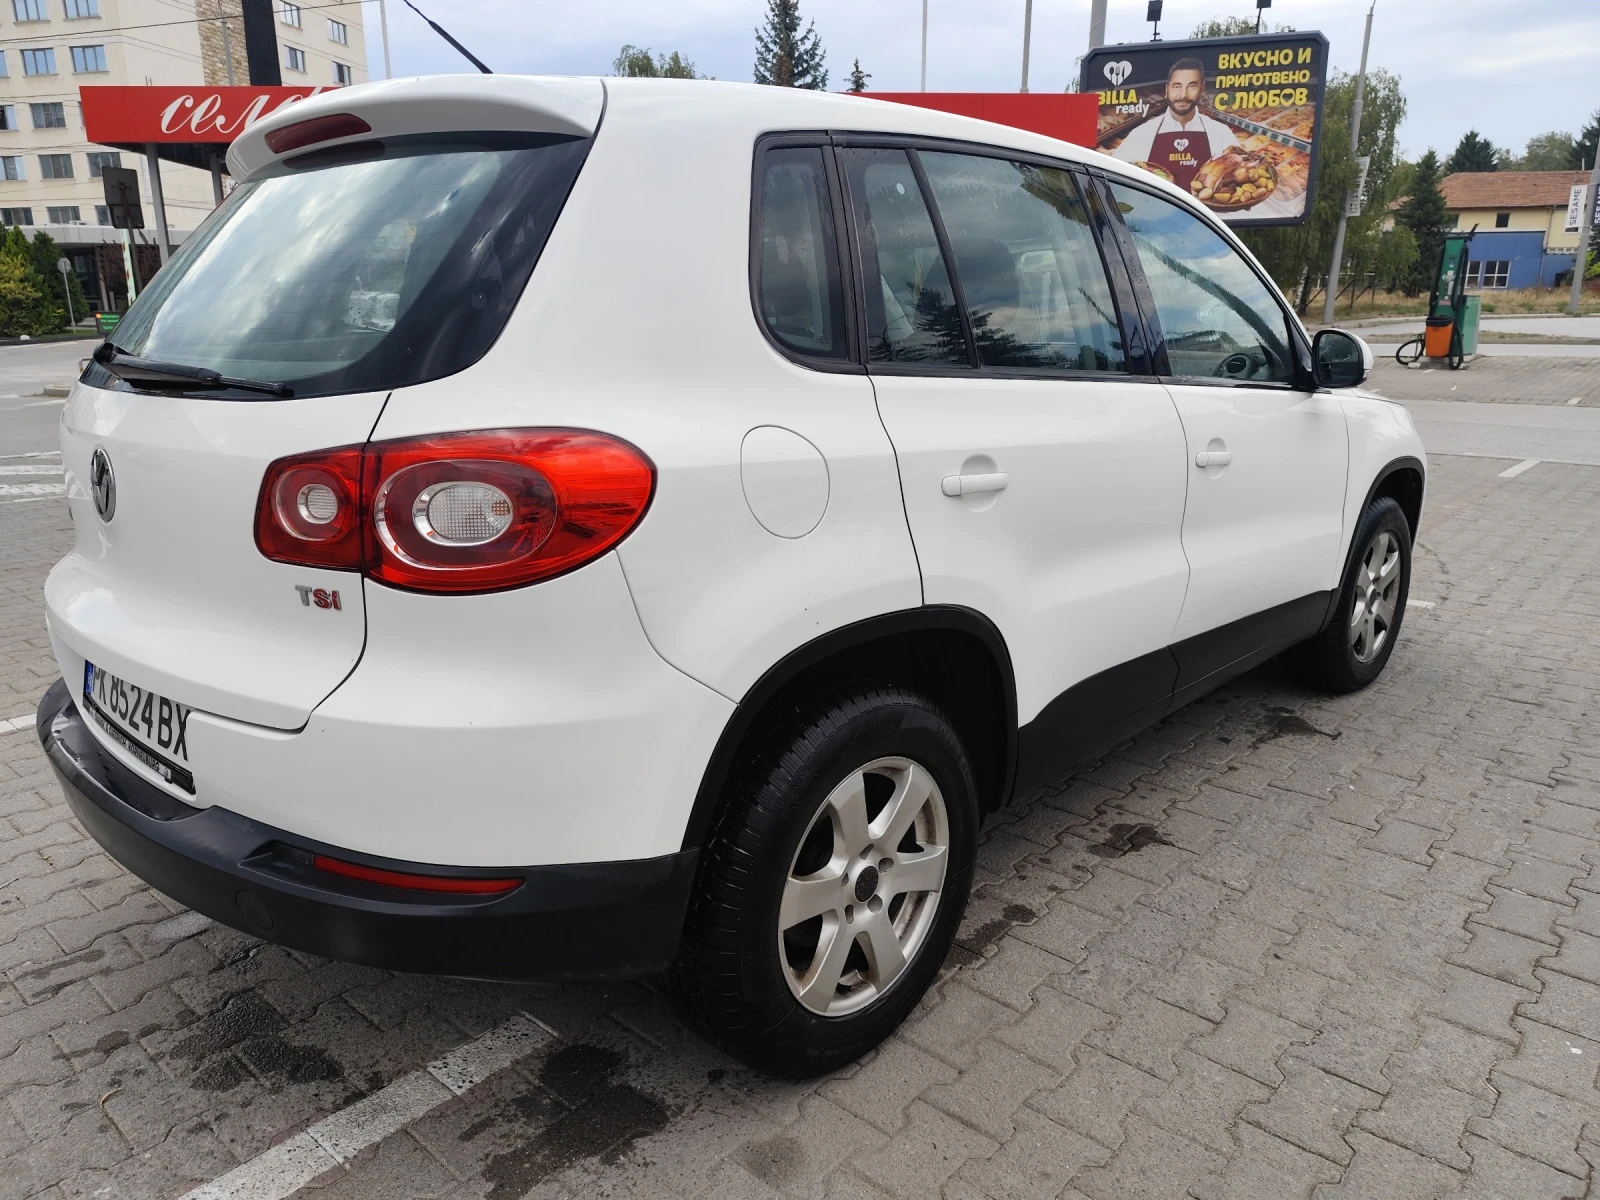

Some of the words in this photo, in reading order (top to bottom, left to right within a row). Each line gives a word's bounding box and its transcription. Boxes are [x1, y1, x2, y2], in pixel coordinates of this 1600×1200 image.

[1218, 48, 1294, 70] ВКУСНО
[1297, 47, 1312, 64] И
[1215, 69, 1311, 89] ПРИГОТВЕНО
[1115, 98, 1150, 118] ready
[1214, 92, 1229, 111] С
[1232, 87, 1309, 110] ЛЮБОВ
[1168, 152, 1192, 161] BILLA
[1179, 157, 1198, 168] ready
[1569, 188, 1582, 226] SESAME
